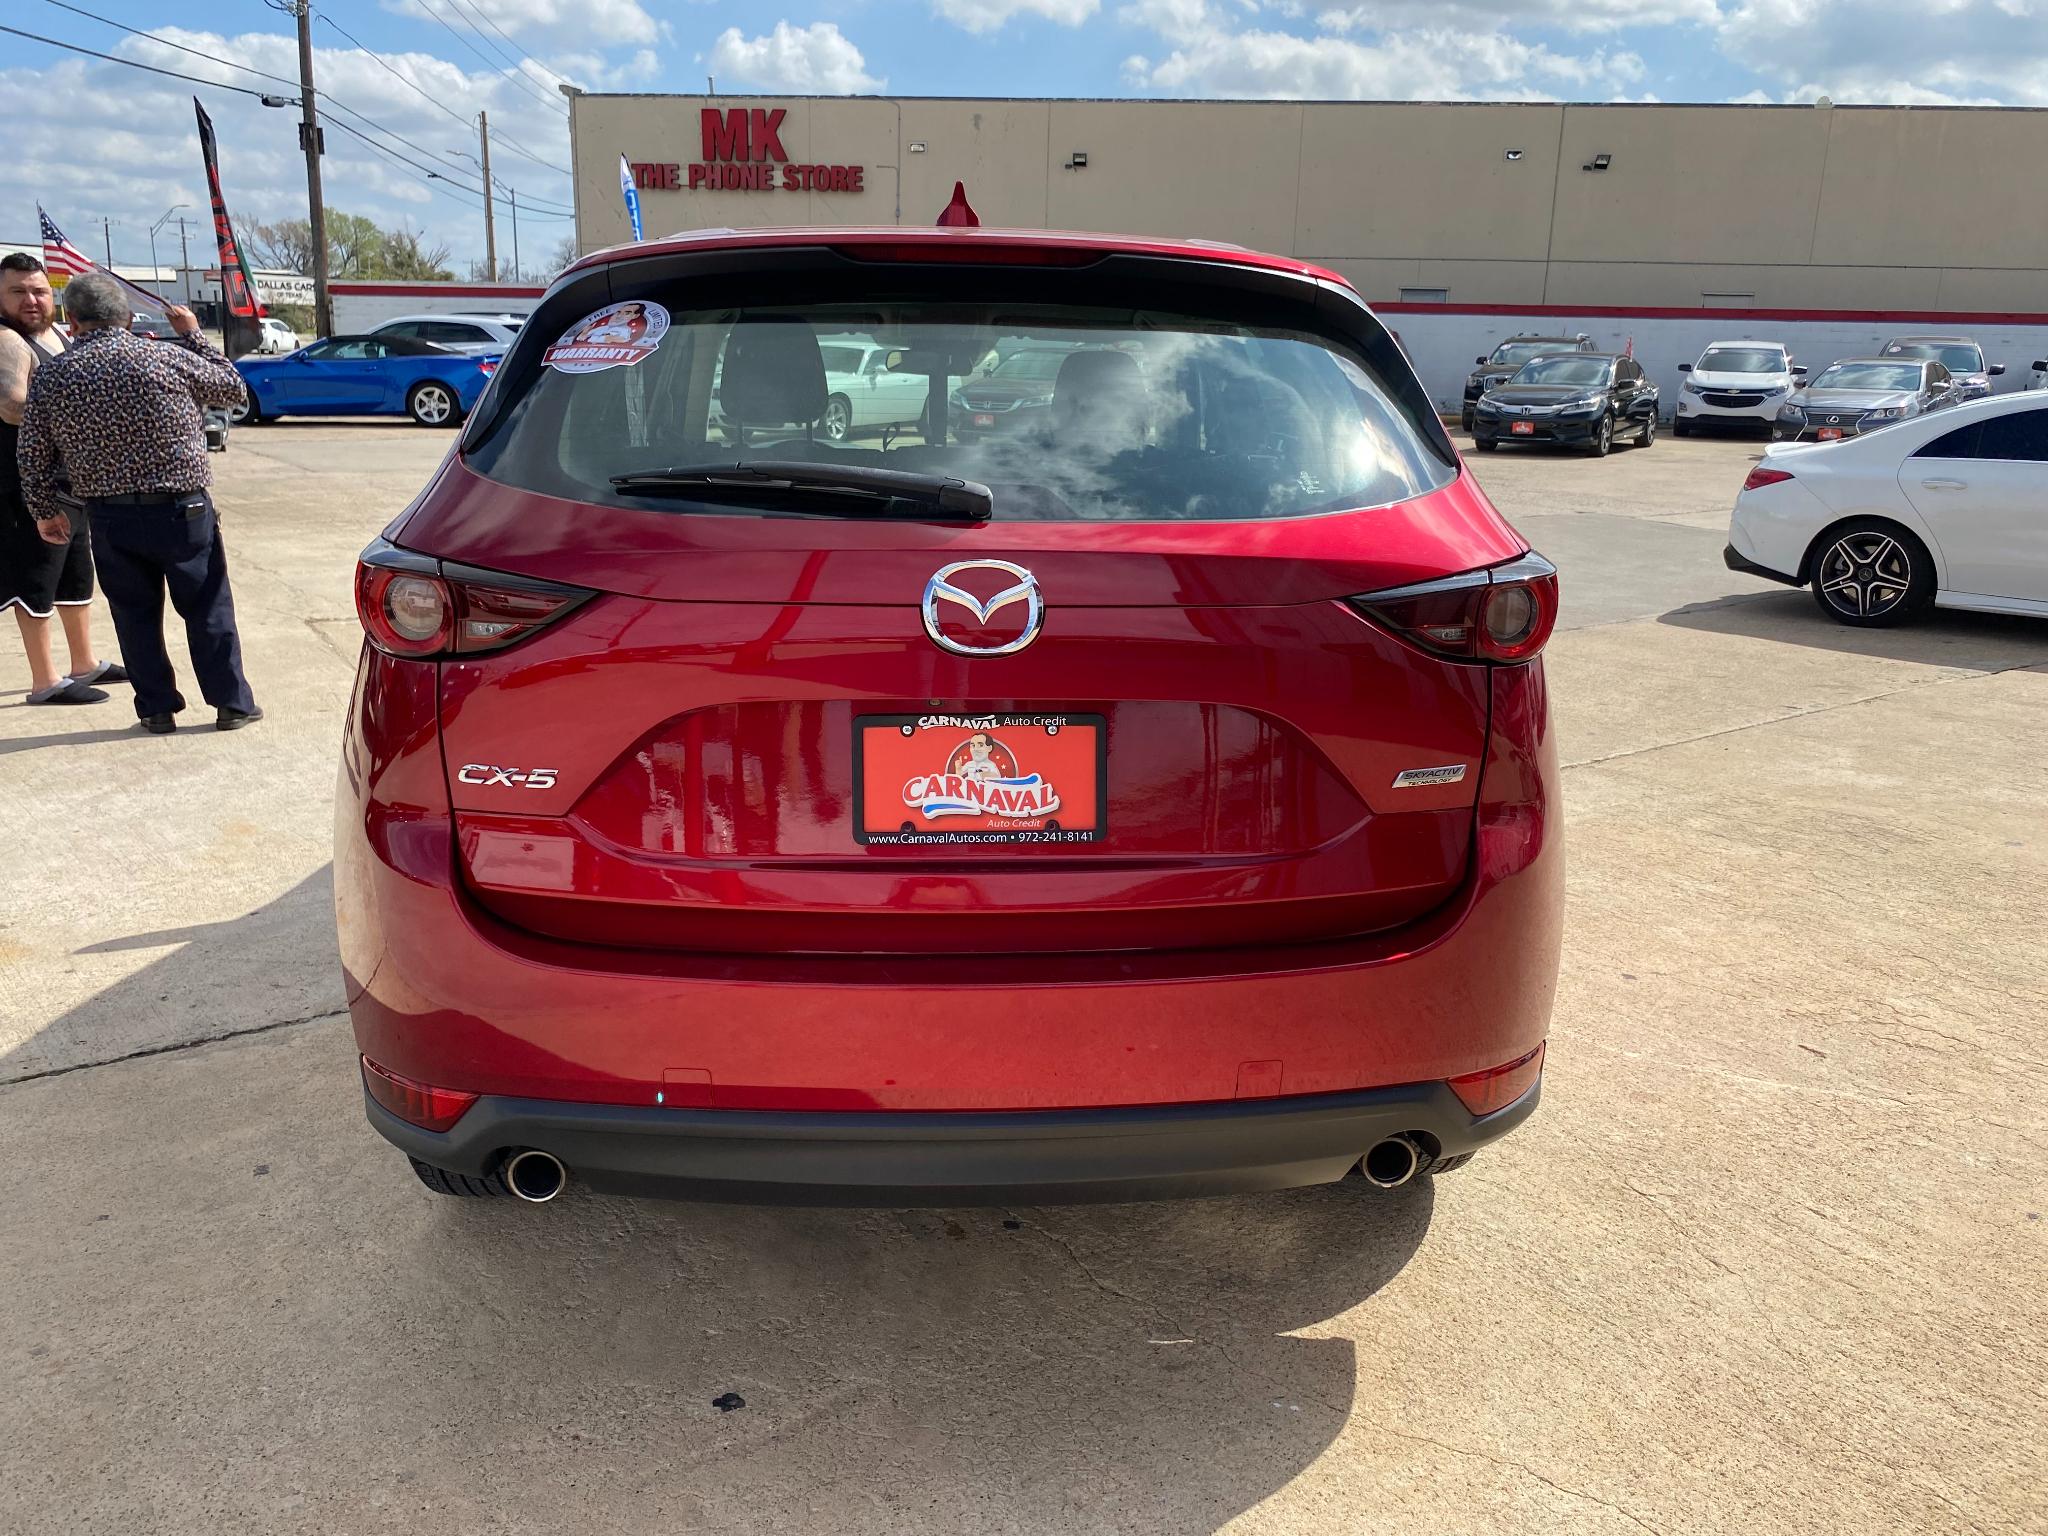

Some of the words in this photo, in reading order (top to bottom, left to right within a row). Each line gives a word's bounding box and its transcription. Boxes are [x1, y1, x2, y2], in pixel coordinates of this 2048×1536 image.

[701, 108, 789, 162] MK
[631, 163, 680, 190] THE
[688, 163, 775, 191] PHONE
[783, 164, 864, 192] STORE
[257, 280, 292, 291] DALLAS
[286, 291, 303, 299] TEXAS
[549, 347, 641, 361] WARRANTY
[917, 714, 1001, 730] CARNAVAL
[1004, 716, 1031, 726] Auto
[1033, 716, 1067, 726] Credit
[458, 763, 559, 789] CX-5
[1404, 768, 1460, 780] SKYACTIV
[903, 775, 1058, 814] CARNAVAL
[987, 819, 1010, 829] Auto
[1011, 819, 1041, 829] Credit
[868, 832, 1007, 844] www.CarnavalAutos.com
[1018, 832, 1093, 843] 972-241-8141
